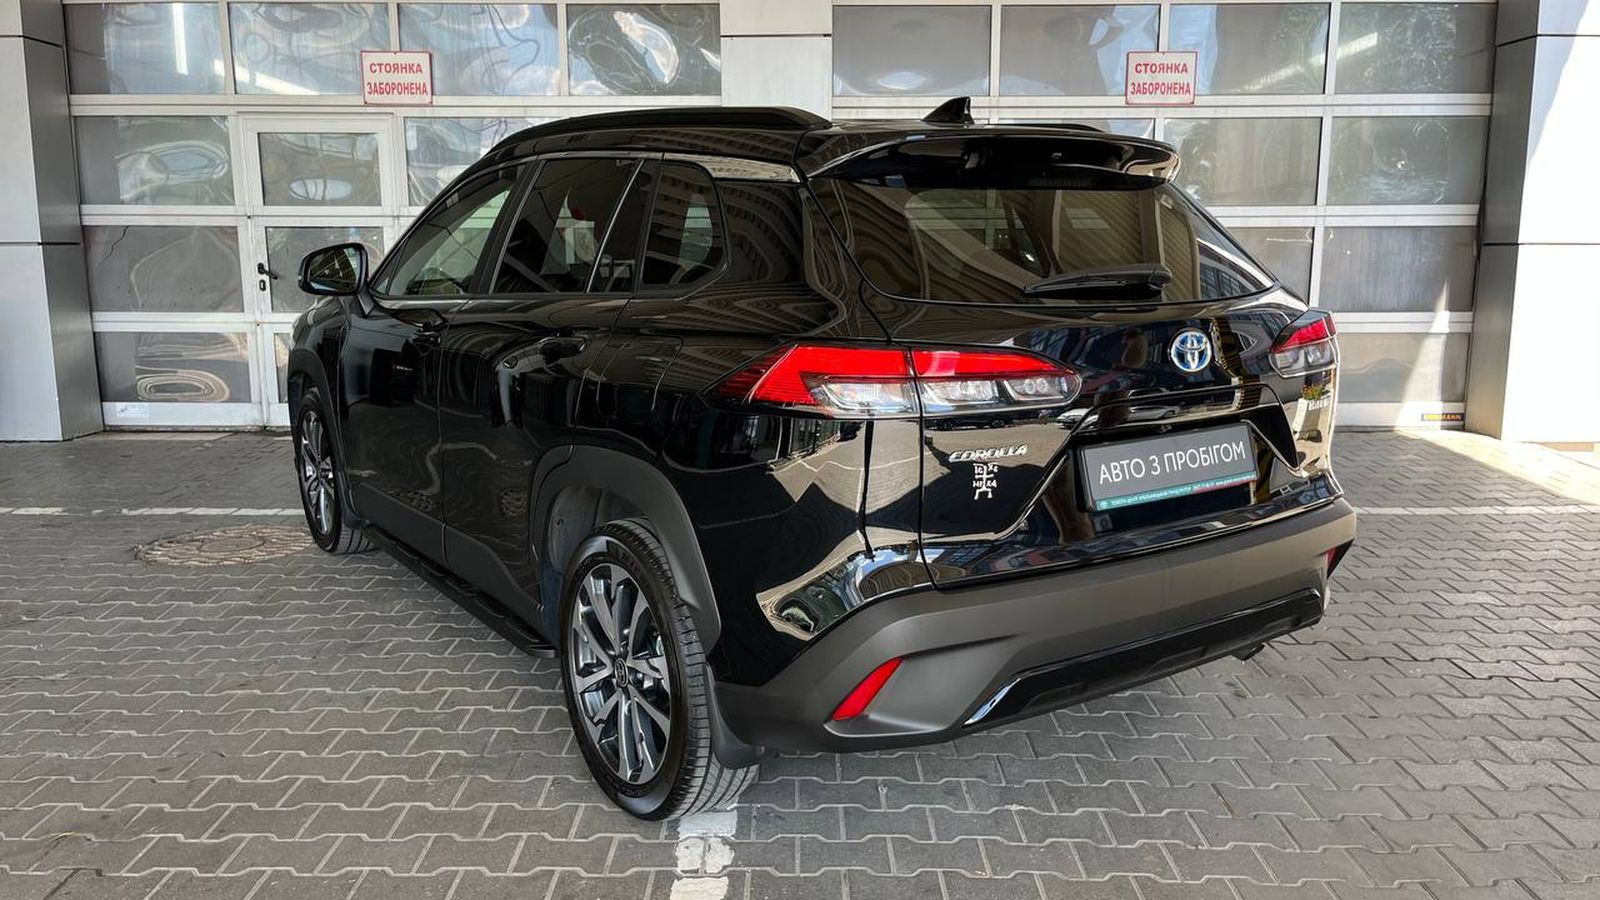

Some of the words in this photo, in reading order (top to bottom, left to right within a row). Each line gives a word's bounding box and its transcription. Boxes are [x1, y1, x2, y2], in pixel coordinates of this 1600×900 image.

[369, 63, 422, 73] СТОЯНКА
[1135, 63, 1188, 73] СТОЯНКА
[367, 82, 428, 95] ЗАБОРОНЕНА
[1130, 82, 1191, 95] ЗАБОРОНЕНА
[948, 444, 1028, 462] COROLLA
[1099, 458, 1145, 485] АВТО
[1163, 441, 1246, 472] ПРОБІГОМ
